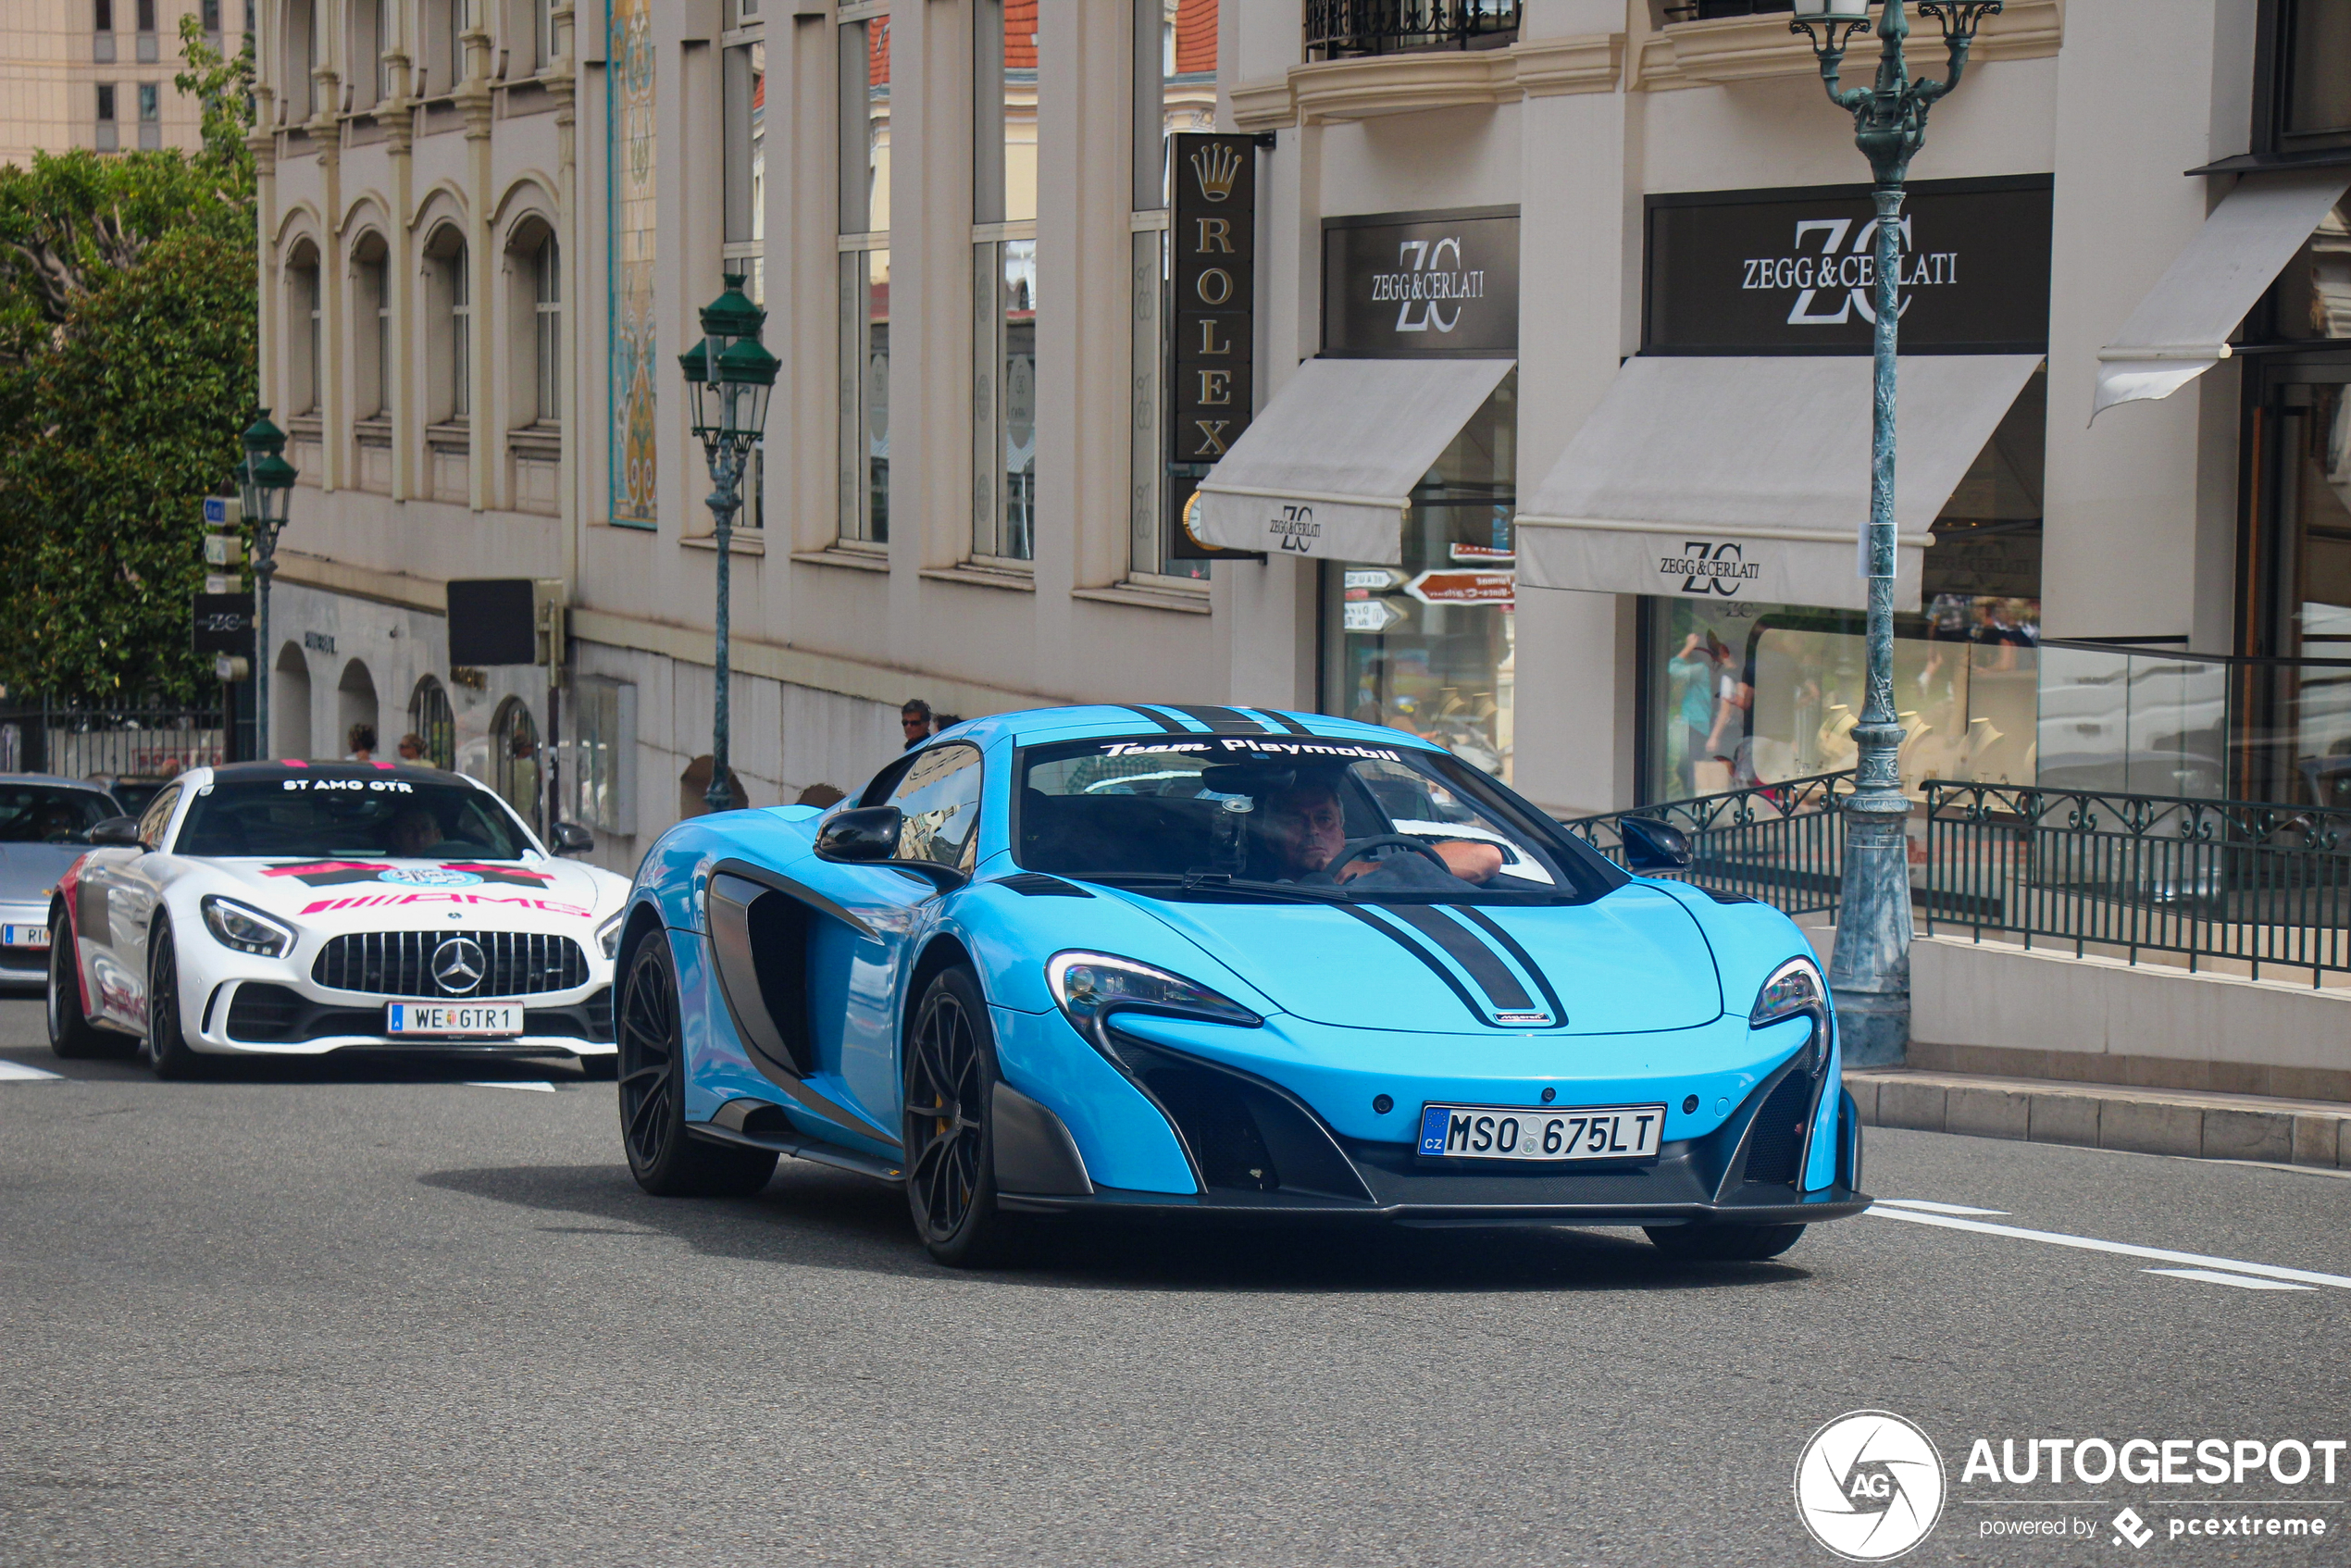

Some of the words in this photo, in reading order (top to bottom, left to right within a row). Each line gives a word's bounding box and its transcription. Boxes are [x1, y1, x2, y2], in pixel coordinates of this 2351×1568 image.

[1195, 218, 1235, 454] ROLEX
[1100, 742, 1212, 757] Team
[1220, 739, 1402, 763] Playmobil
[283, 779, 309, 790] ST
[314, 779, 364, 791] AMG
[369, 780, 414, 794] GTR
[396, 892, 593, 918] AMG
[28, 929, 42, 943] RI
[416, 1009, 443, 1027] WE
[1424, 1138, 1442, 1150] CZ
[1448, 1114, 1520, 1152] MSO
[1543, 1114, 1655, 1154] 675LT
